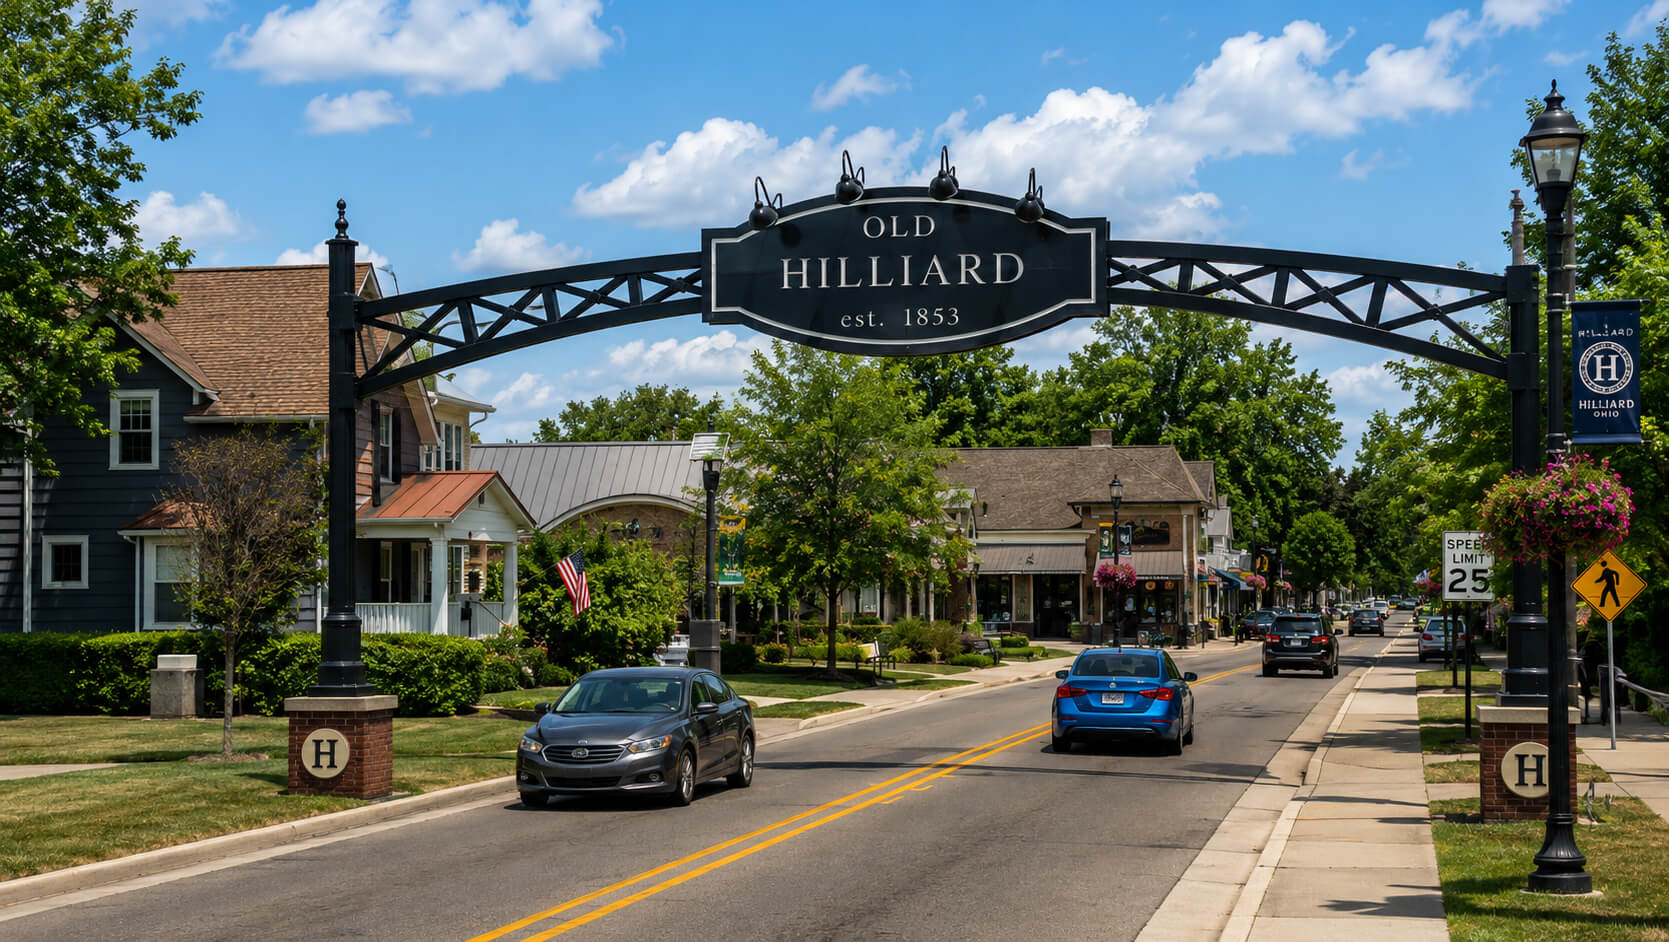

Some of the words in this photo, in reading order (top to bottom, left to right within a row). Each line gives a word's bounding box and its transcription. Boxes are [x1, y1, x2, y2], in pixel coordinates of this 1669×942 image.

[863, 215, 936, 239] OLD
[780, 251, 1025, 289] HILLIARD
[840, 309, 885, 328] est.
[903, 306, 960, 327] 1853
[1593, 354, 1620, 382] H
[1579, 399, 1635, 409] HILLIARD
[1593, 410, 1619, 418] OHIO
[1447, 539, 1482, 550] SPEE
[1453, 553, 1485, 564] LIMIT
[1448, 568, 1490, 593] 25
[312, 739, 338, 769] H
[1514, 754, 1547, 787] H
